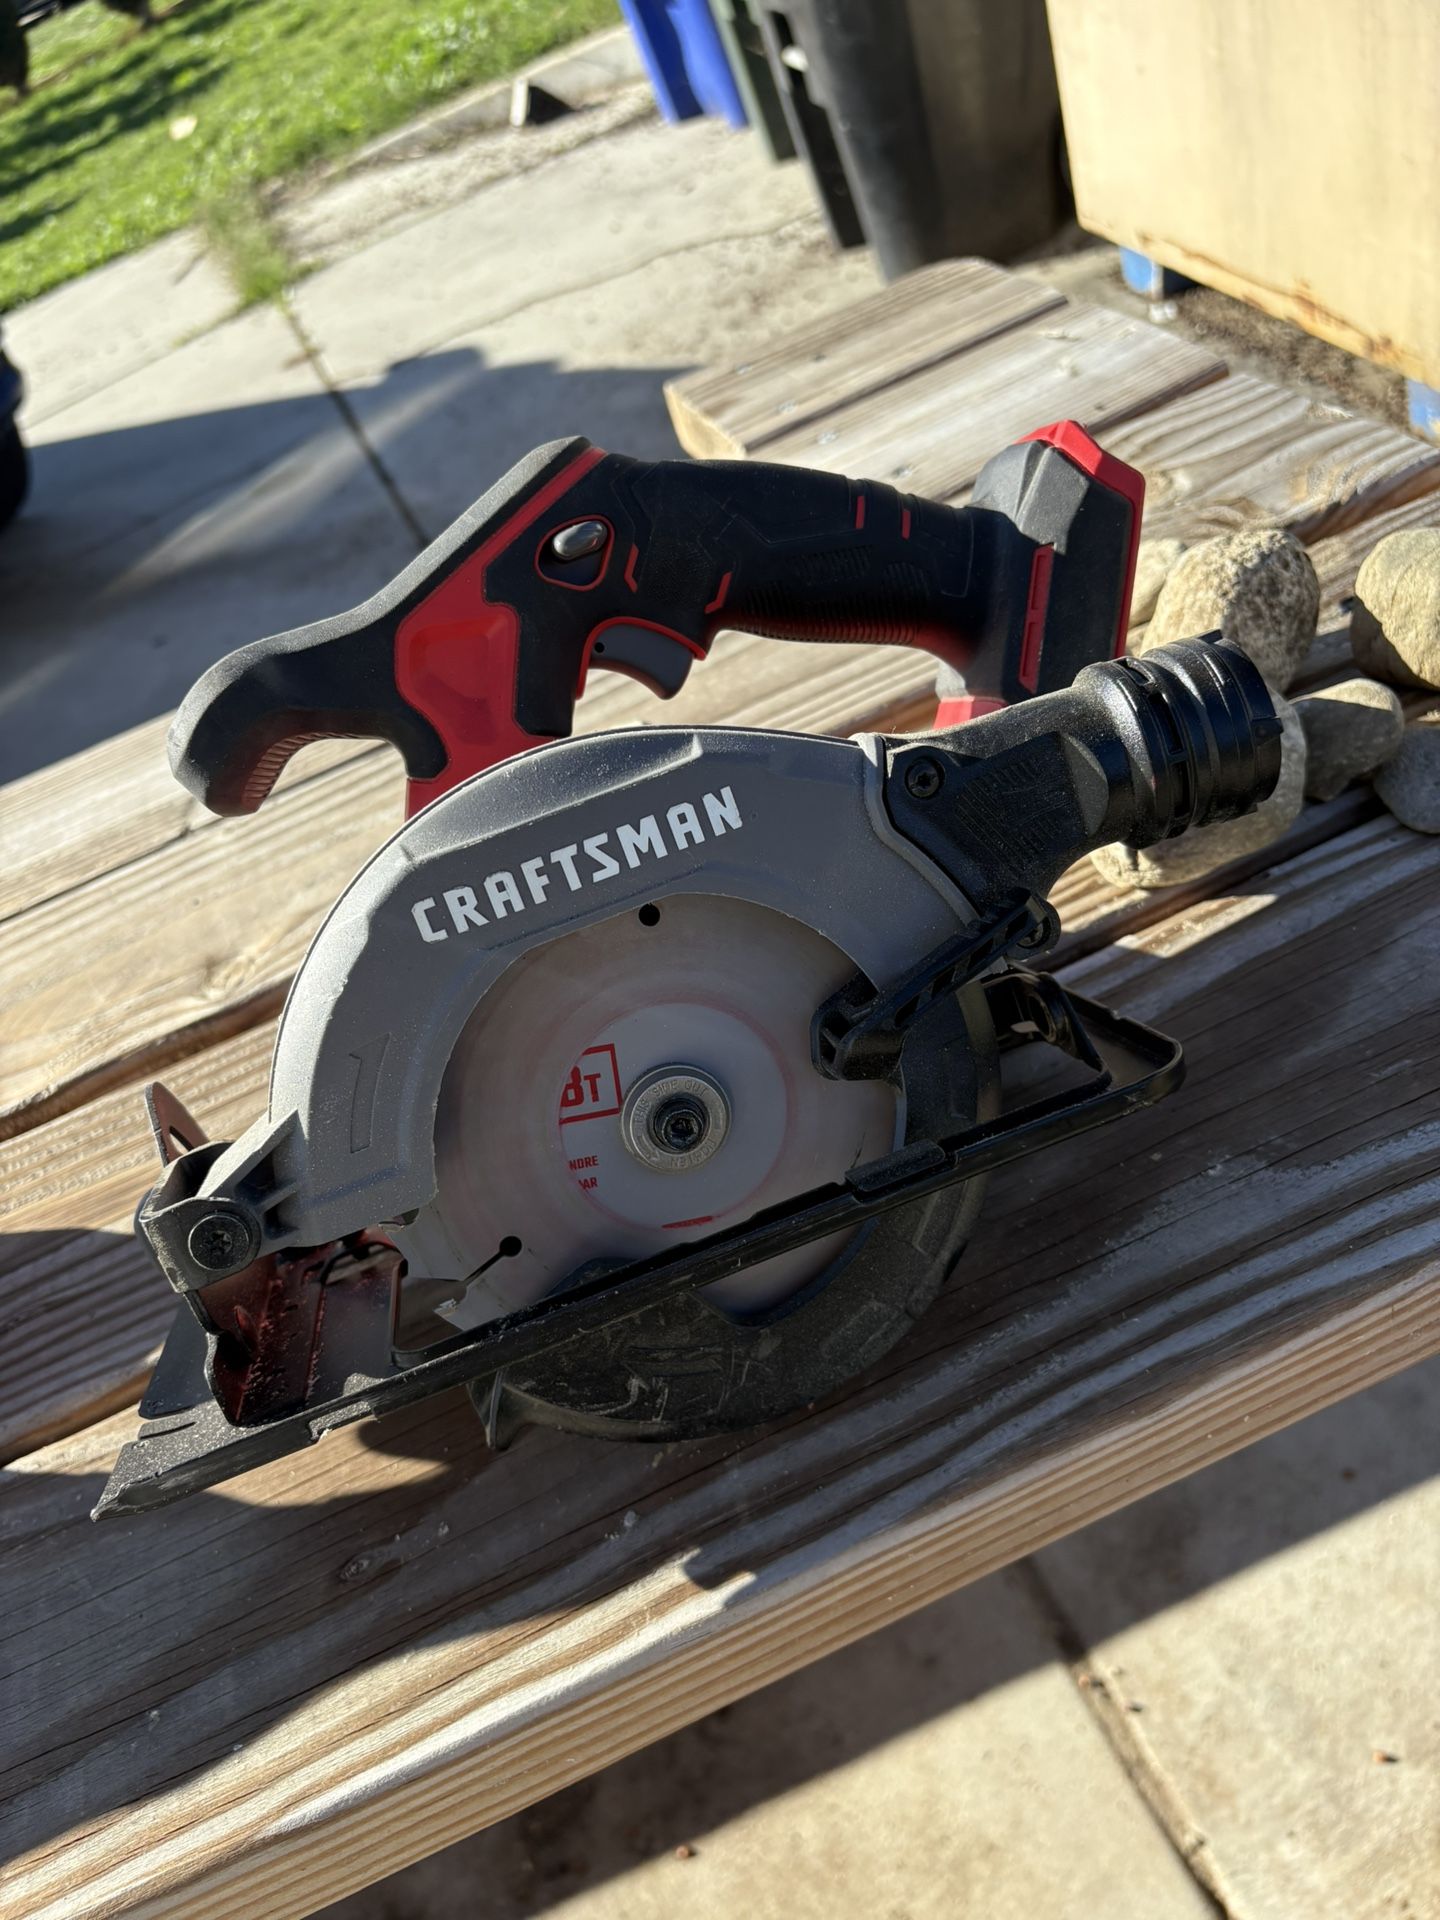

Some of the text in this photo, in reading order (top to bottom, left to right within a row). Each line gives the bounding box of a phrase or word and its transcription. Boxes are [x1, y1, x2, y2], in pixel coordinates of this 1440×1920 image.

[411, 786, 743, 943] CRAFTSMAN
[634, 1080, 708, 1125] THIS SIDE OUT
